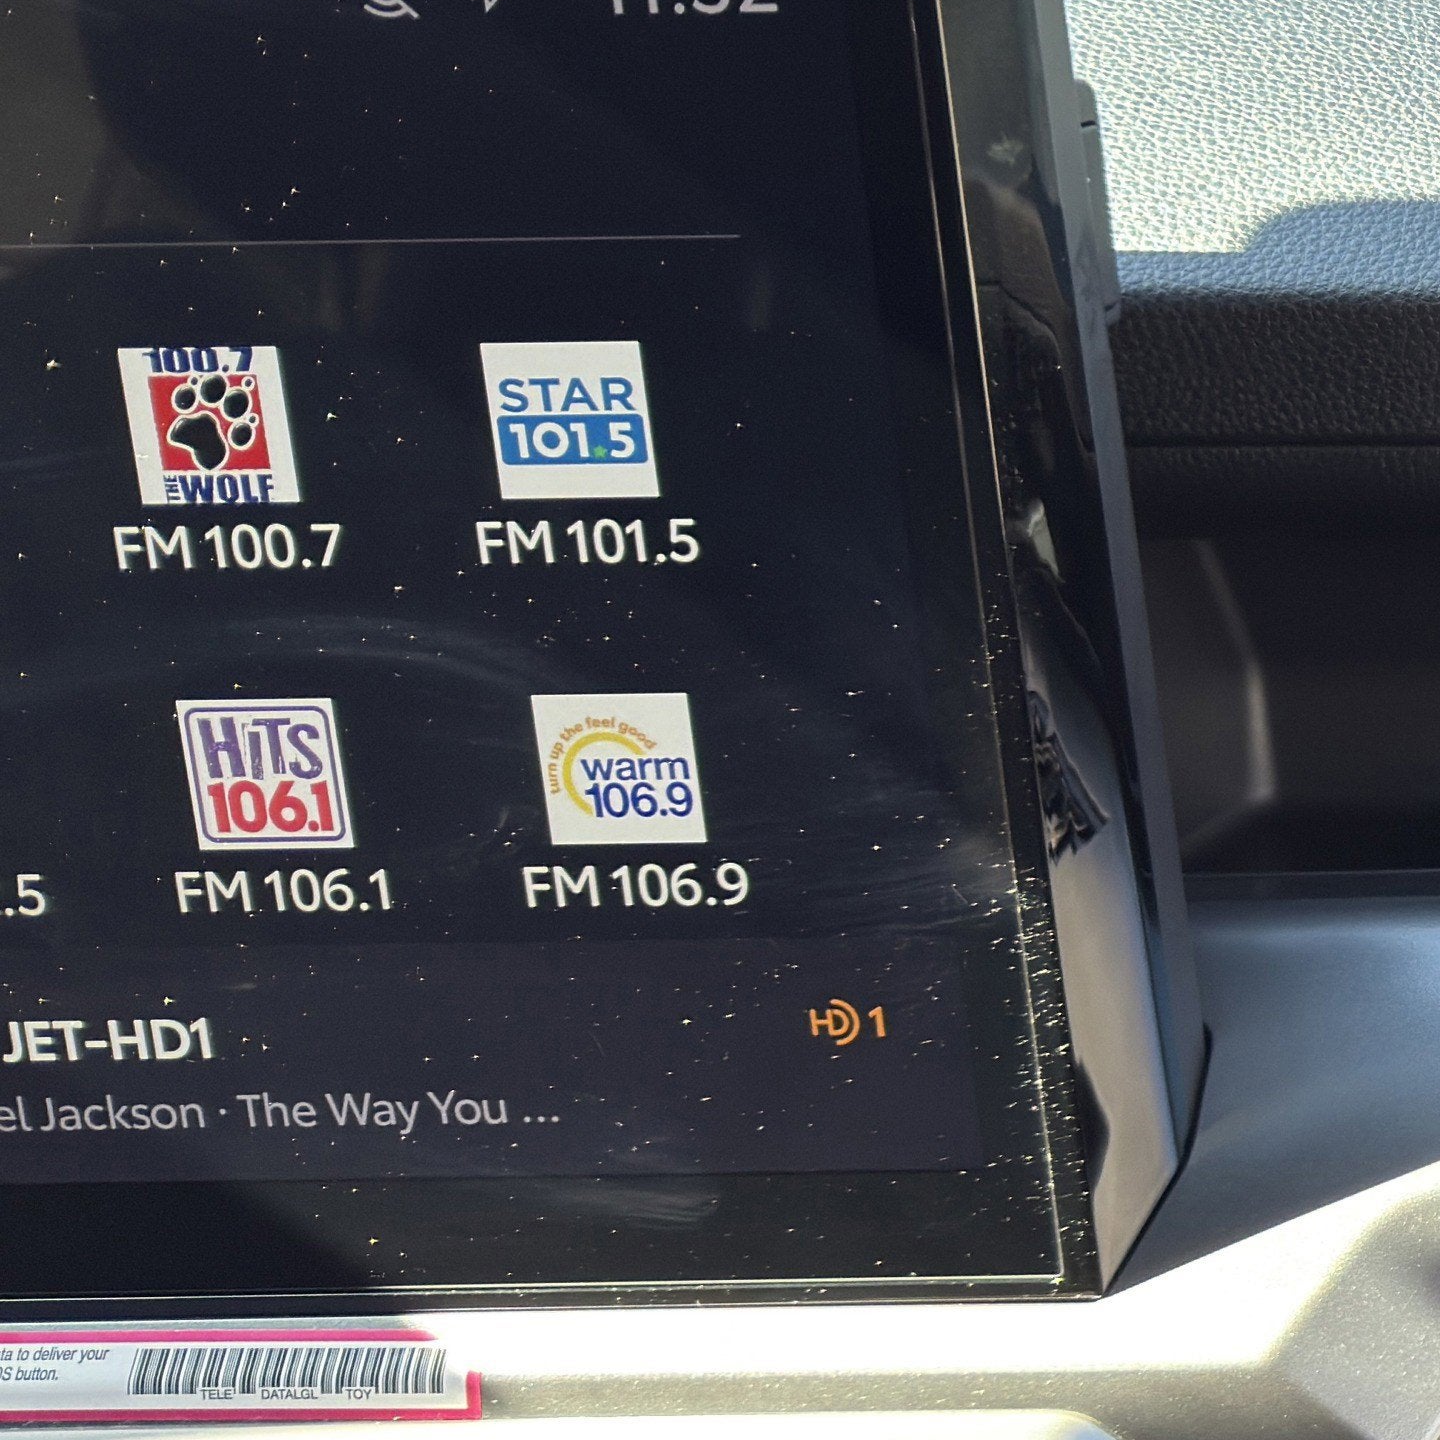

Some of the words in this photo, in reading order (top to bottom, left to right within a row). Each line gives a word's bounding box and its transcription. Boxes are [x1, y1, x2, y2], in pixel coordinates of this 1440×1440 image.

[498, 377, 637, 413] STAR
[164, 474, 181, 503] THE
[178, 474, 275, 503] WOLF
[113, 525, 193, 570] FM
[205, 523, 341, 569] 100.7
[475, 520, 555, 564] FM
[566, 518, 699, 564] 101.5
[584, 716, 615, 729] feel
[579, 756, 691, 781] warm
[206, 779, 335, 834] 106.1
[584, 781, 694, 818] 106.9
[174, 870, 252, 913] FM
[264, 868, 391, 912] 106.1
[522, 865, 601, 908] FM
[611, 862, 749, 907] 106.9
[3, 1017, 214, 1063] JET-HD1
[40, 1094, 206, 1132] Jackson
[236, 1091, 317, 1128] The
[325, 1091, 420, 1135] Way
[426, 1090, 509, 1126] You
[16, 1347, 29, 1361] to
[32, 1346, 78, 1361] deliver
[78, 1348, 111, 1364] your
[15, 1366, 59, 1381] button.
[200, 1388, 234, 1400] TELE
[260, 1388, 319, 1400] DATALGL
[345, 1388, 373, 1400] TOY
